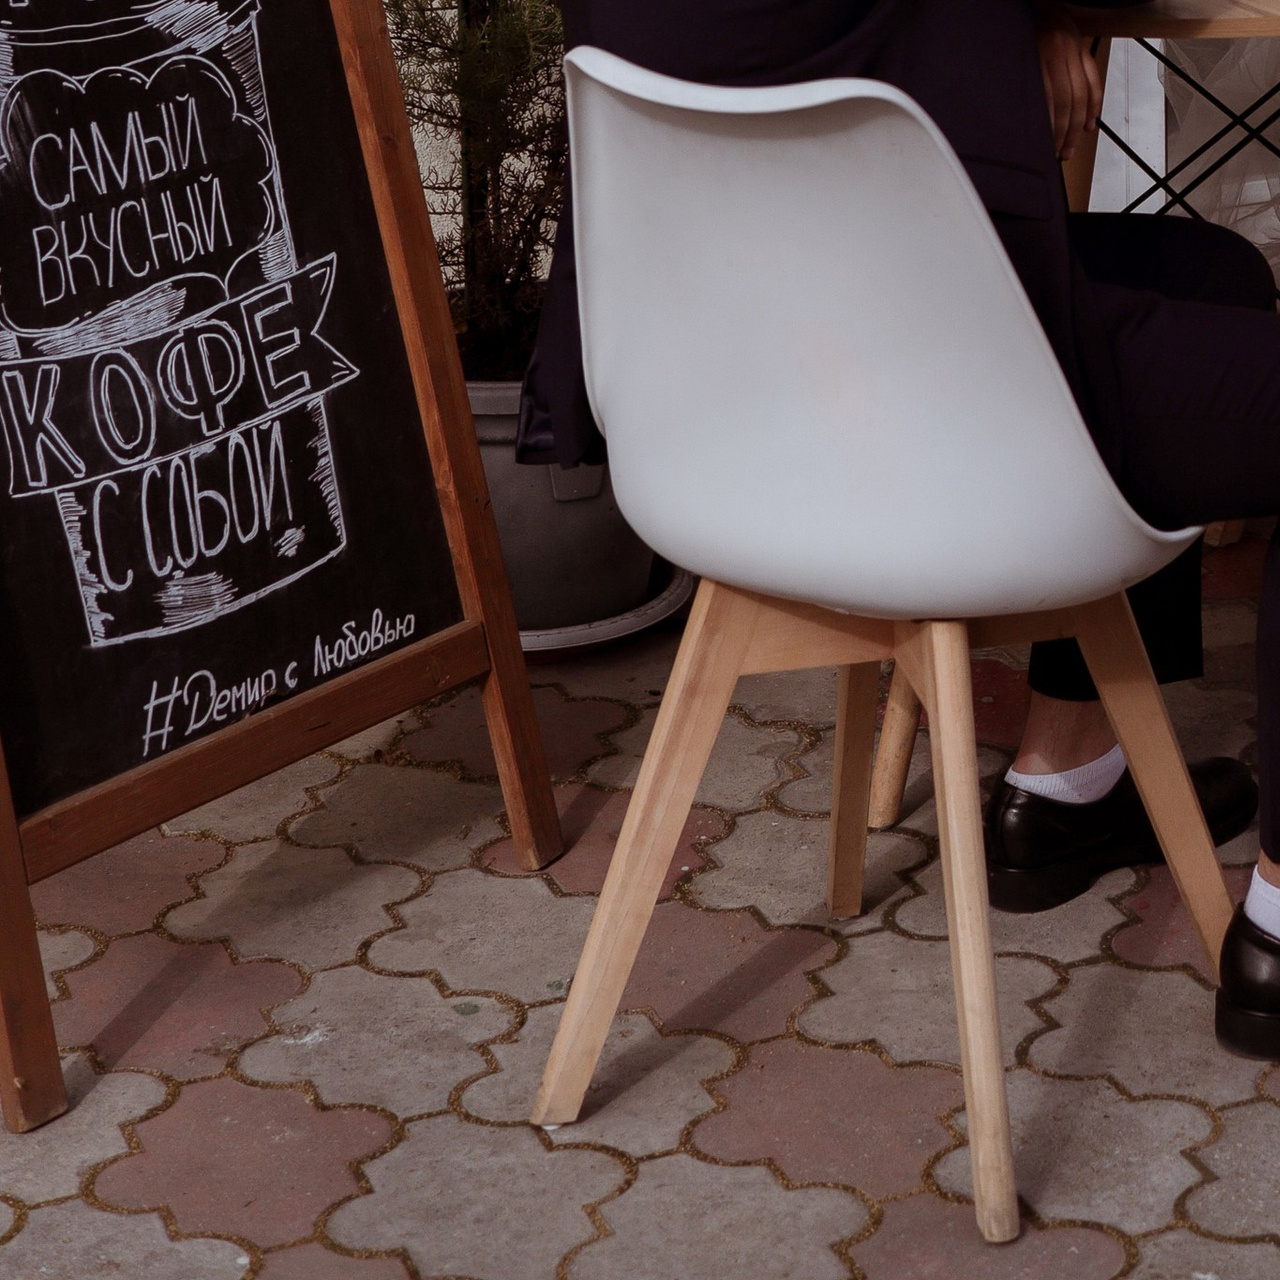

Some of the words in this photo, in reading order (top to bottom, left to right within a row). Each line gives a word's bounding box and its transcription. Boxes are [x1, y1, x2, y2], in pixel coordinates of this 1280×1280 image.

[29, 94, 208, 210] САМЫЙ
[32, 173, 232, 305] ВКУСНЫЙ
[2, 281, 311, 488] КОФЕ
[92, 479, 133, 592] С
[141, 420, 294, 578] СОБОЙ
